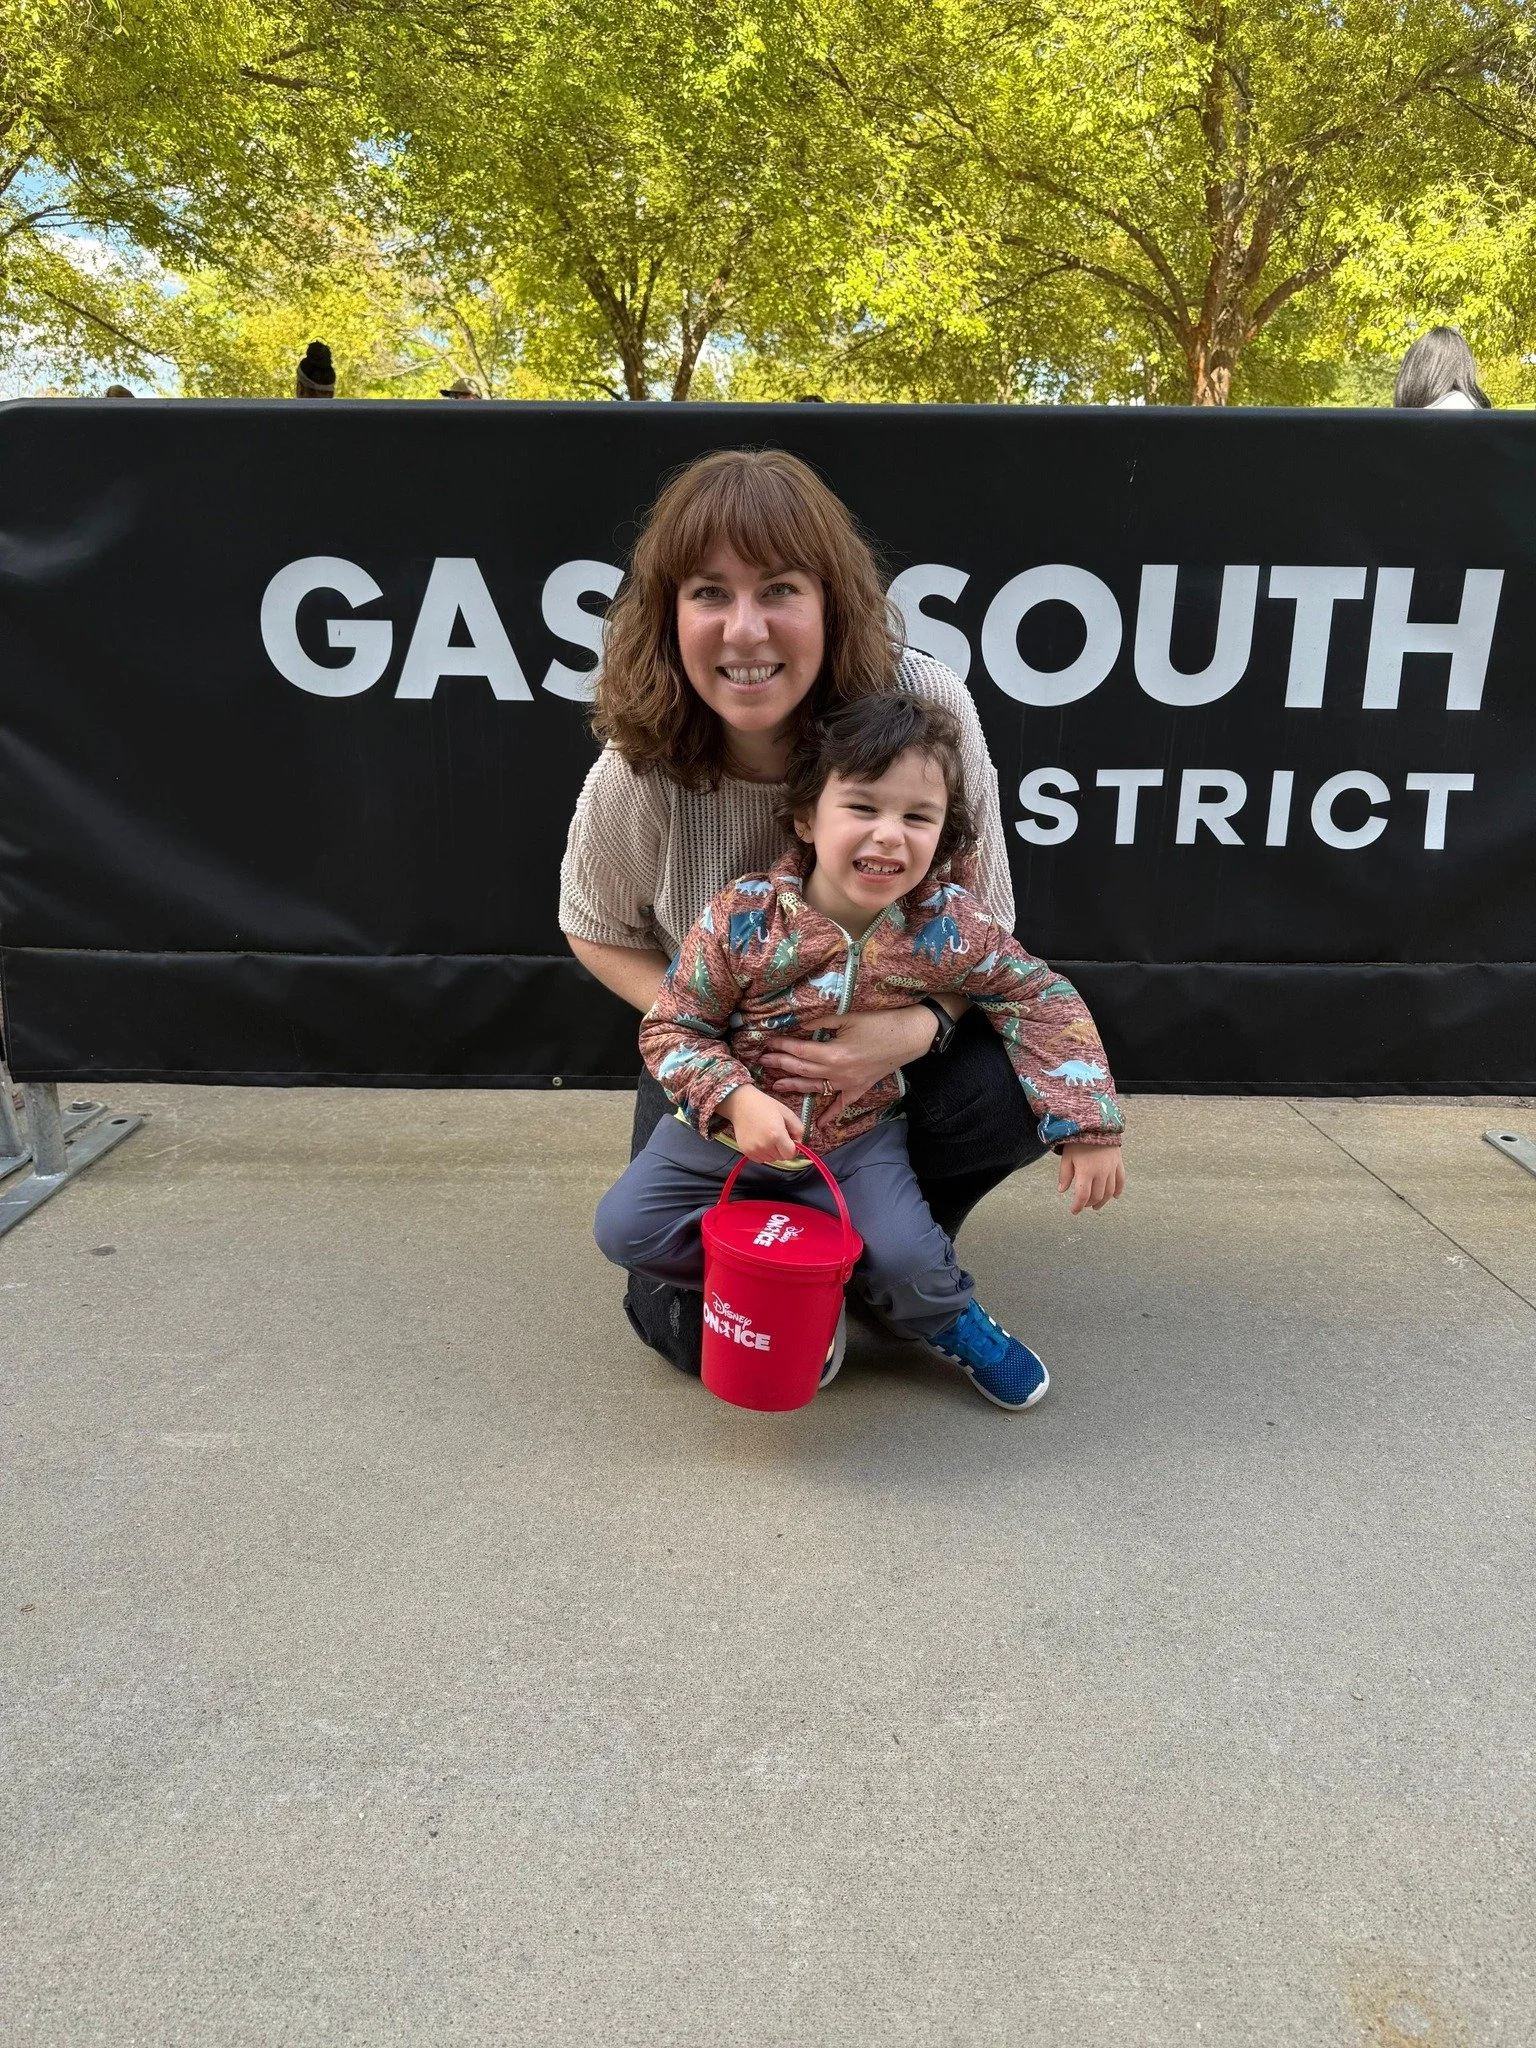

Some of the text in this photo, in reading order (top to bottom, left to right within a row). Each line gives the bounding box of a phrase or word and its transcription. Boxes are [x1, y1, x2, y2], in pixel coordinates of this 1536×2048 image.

[260, 556, 1505, 711] GAS SOUTH
[994, 767, 1475, 850] STRICT
[753, 1214, 790, 1247] ON ICE
[703, 1302, 771, 1351] ON ICE
[712, 1291, 752, 1330] Disney
